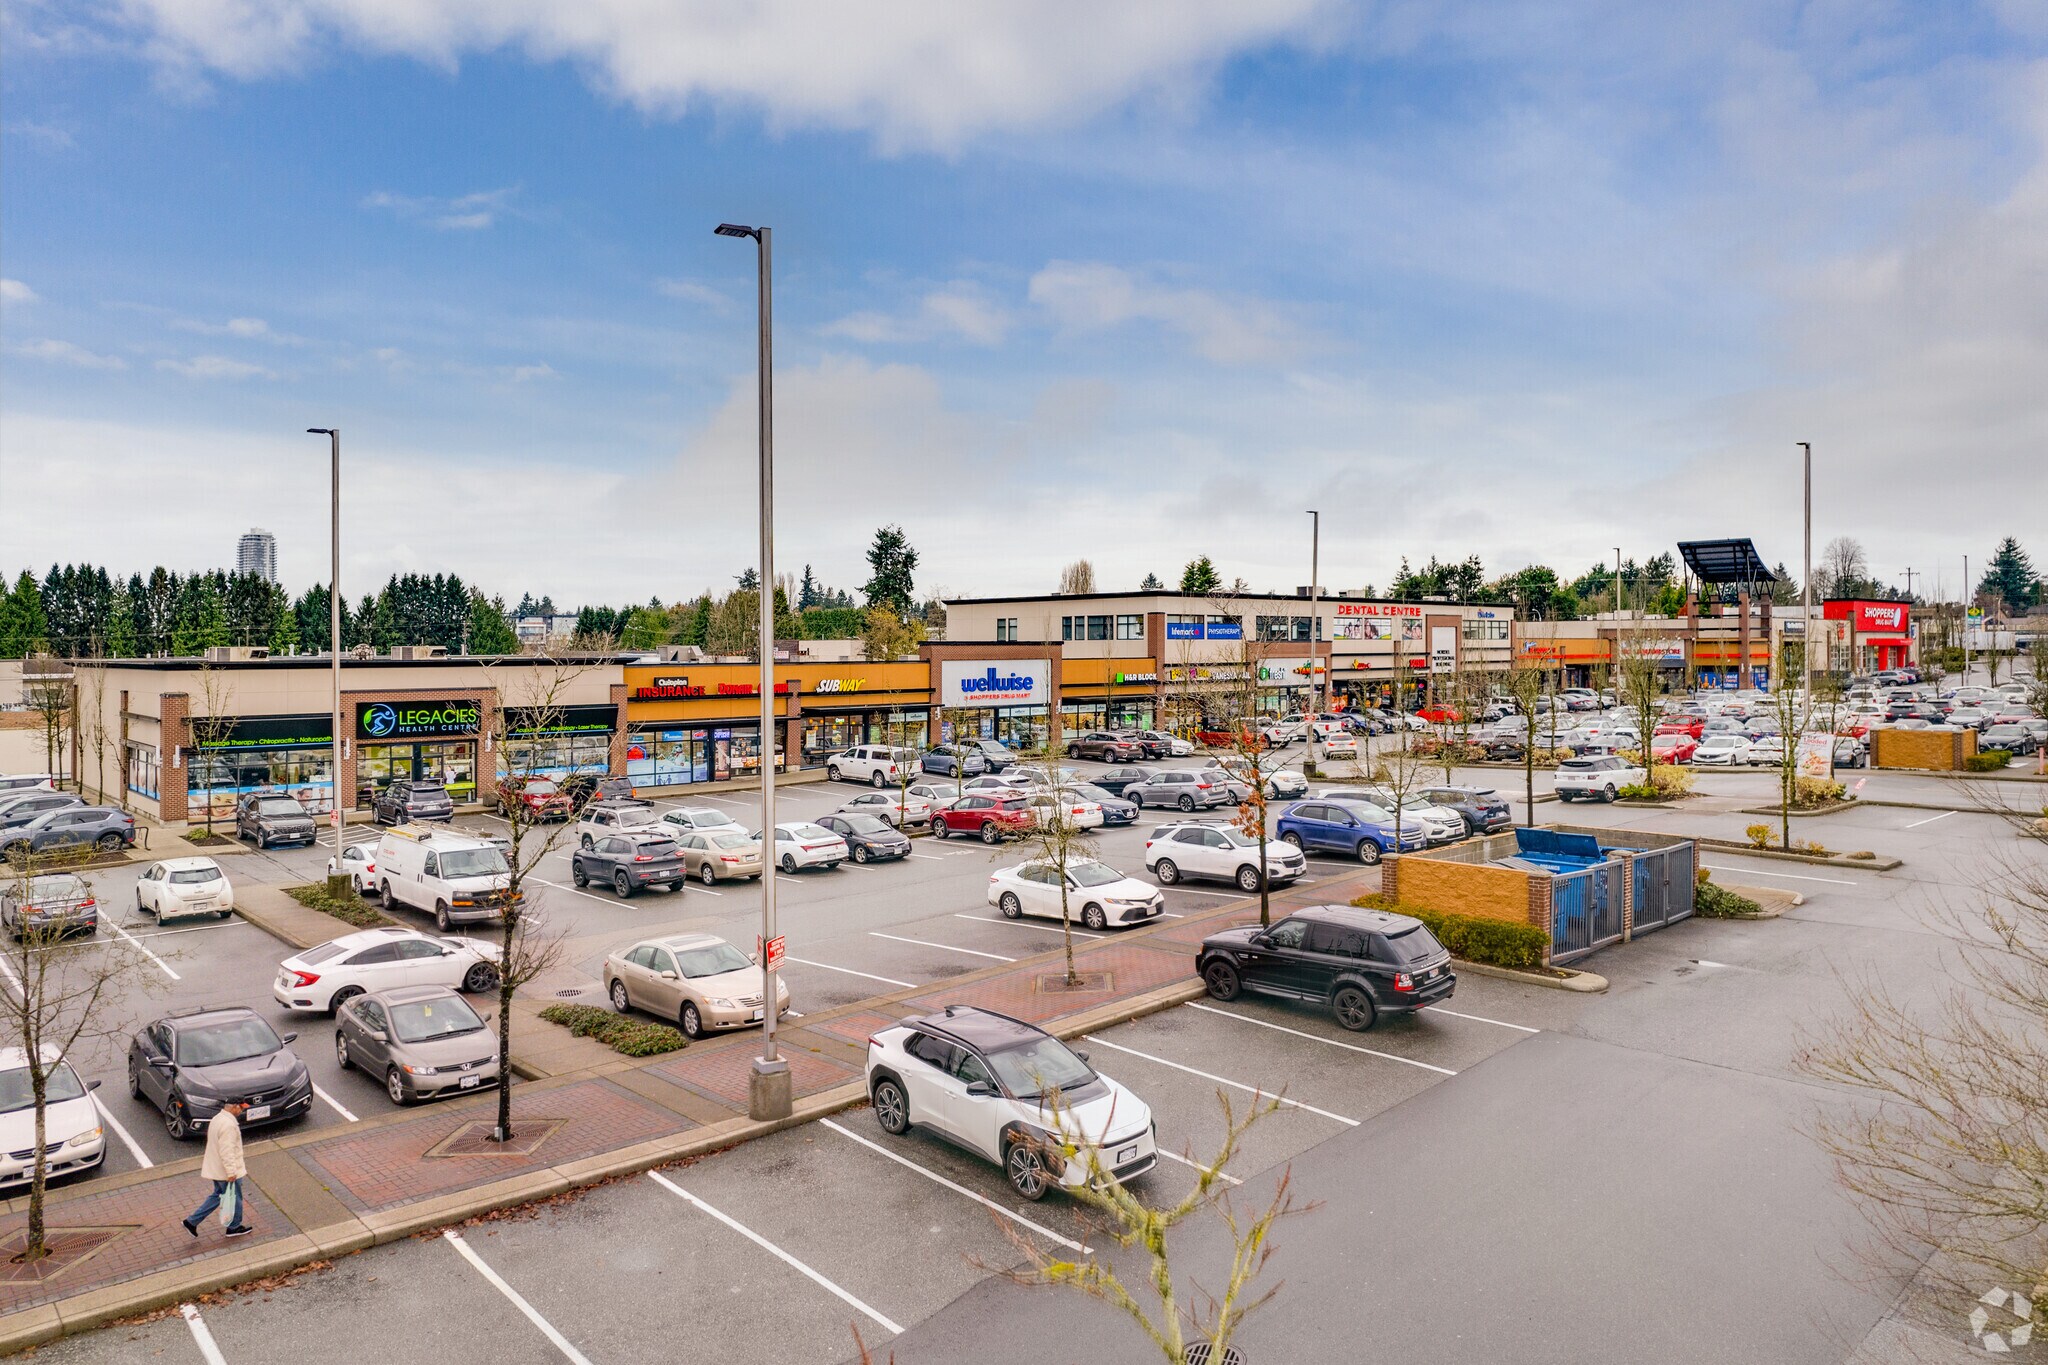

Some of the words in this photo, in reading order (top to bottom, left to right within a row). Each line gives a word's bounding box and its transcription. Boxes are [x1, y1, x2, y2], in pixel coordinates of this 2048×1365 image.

[1337, 605, 1379, 615] DENTAL
[1383, 606, 1421, 616] CENTRE
[1864, 607, 1895, 618] SHOPPERS
[1171, 627, 1194, 635] lifemark
[961, 667, 1033, 692] wellwise
[1124, 673, 1137, 681] H&R
[718, 683, 753, 694] DONAIR
[816, 678, 866, 693] SUBWAY
[637, 685, 706, 698] INSURANCE
[399, 709, 477, 725] LEGACIES
